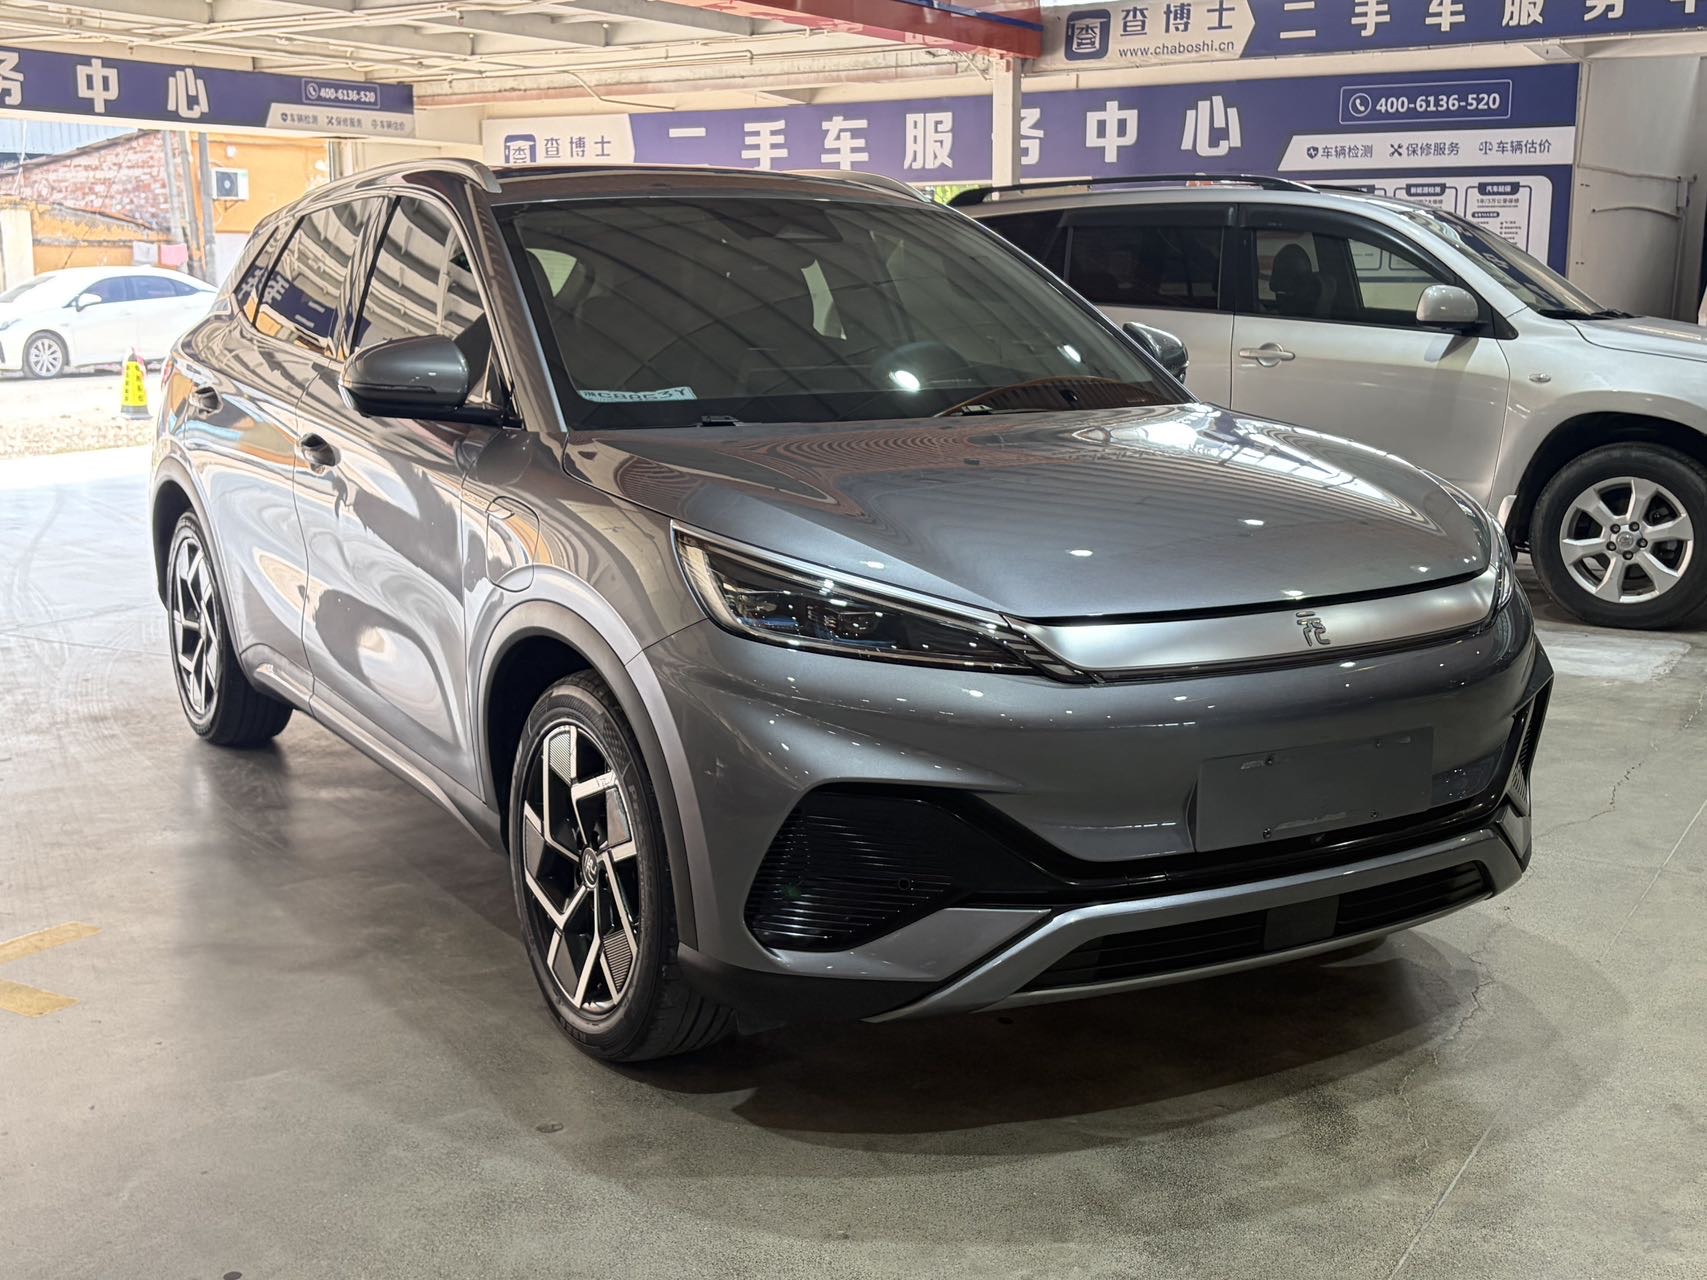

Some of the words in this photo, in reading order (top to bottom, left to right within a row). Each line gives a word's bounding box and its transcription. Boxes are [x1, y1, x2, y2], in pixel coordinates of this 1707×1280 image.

[1119, 0, 1236, 37] 查博士
[1279, 0, 1698, 39] 二手车服
[1118, 40, 1235, 58] www.chaboshi.cn
[319, 87, 376, 103] 400-6136-520
[1375, 92, 1501, 114] 400-6136-520
[543, 135, 612, 159] 查博士
[1320, 144, 1374, 160] 车辆检测
[1405, 141, 1461, 157] 保修服务
[1495, 138, 1552, 155] 车辆估价
